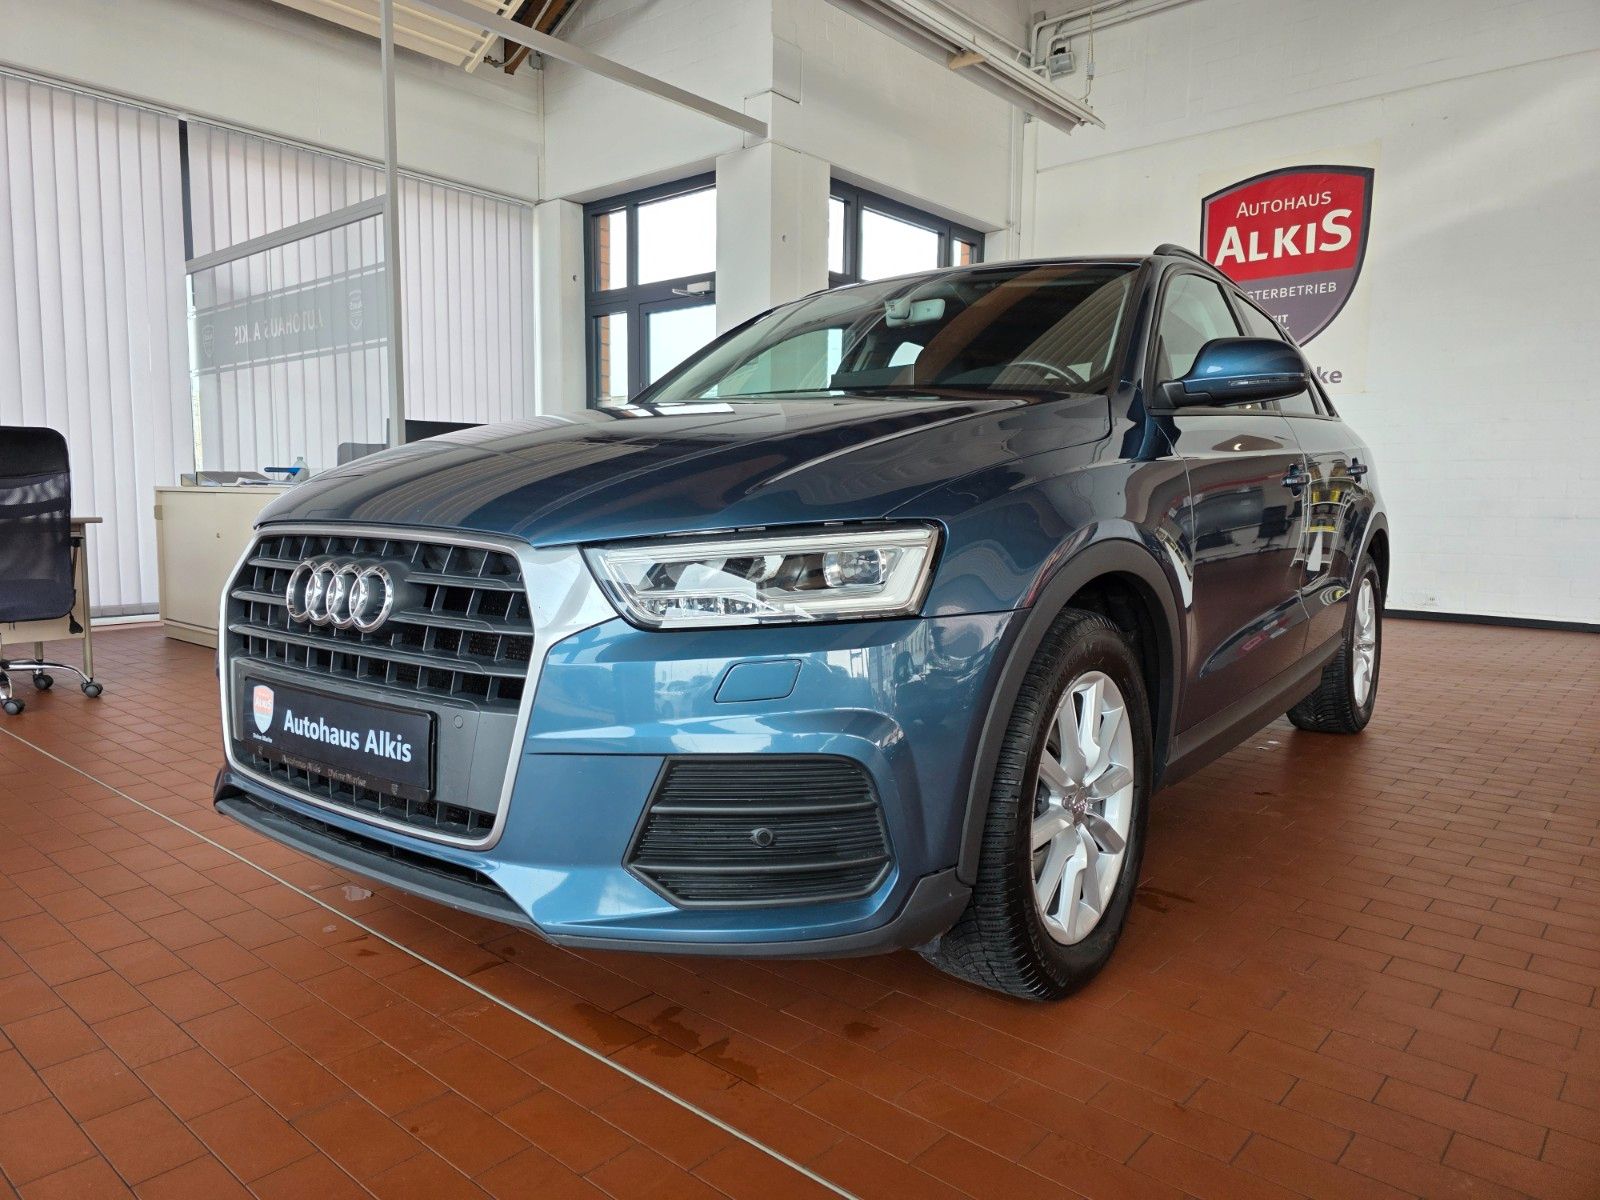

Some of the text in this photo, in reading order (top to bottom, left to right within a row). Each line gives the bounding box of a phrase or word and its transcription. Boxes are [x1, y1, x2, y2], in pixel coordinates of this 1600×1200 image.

[1235, 191, 1332, 219] AUTOHAUS
[1213, 208, 1353, 267] ALKIS
[283, 709, 412, 762] Autohaus Alkis
